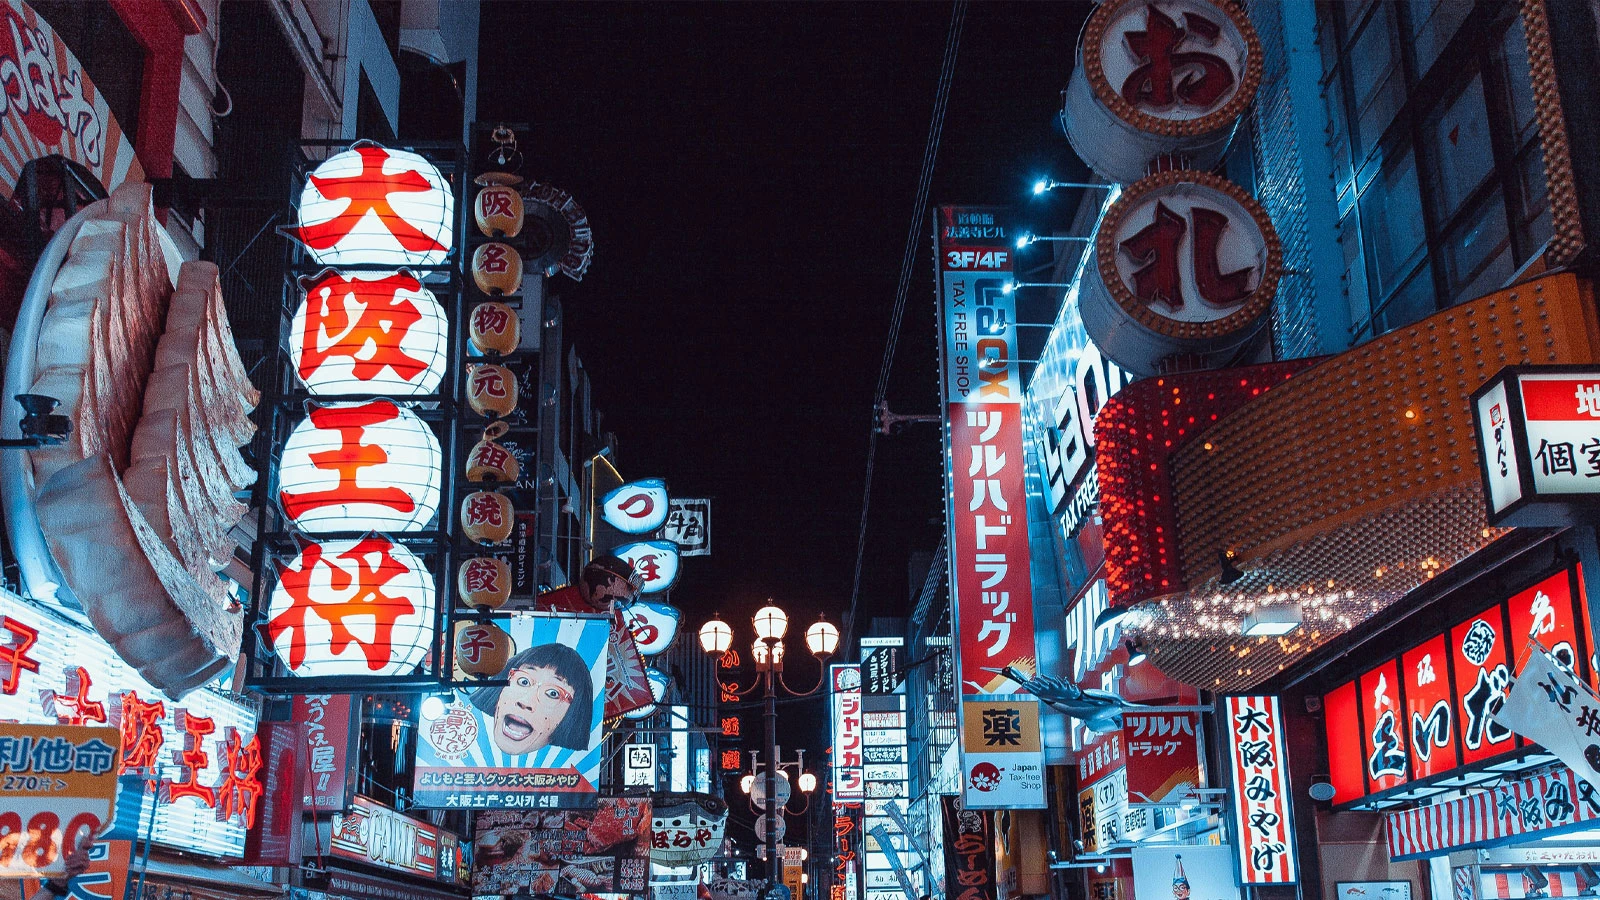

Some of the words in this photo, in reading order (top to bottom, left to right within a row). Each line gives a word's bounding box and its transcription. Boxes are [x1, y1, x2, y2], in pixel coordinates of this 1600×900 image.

[947, 250, 1008, 269] 3F/4F
[952, 279, 967, 308] TAX
[953, 312, 968, 351] FREE
[956, 356, 971, 398] SHOP
[665, 512, 704, 539] 牛角
[966, 411, 1017, 657] ツルハドラッグ
[1059, 506, 1078, 541] TAX
[982, 707, 1022, 746] 薬
[1126, 716, 1194, 738] ツルハ
[842, 697, 861, 789] ジャンカラ
[1128, 740, 1182, 757] ドラッグ
[1008, 773, 1041, 782] Tax-free
[1021, 781, 1042, 791] Shop
[1235, 706, 1286, 871] 大阪みやげ
[1099, 781, 1116, 805] くすり
[651, 828, 712, 849] ぼらや
[658, 885, 696, 895] PASTA
